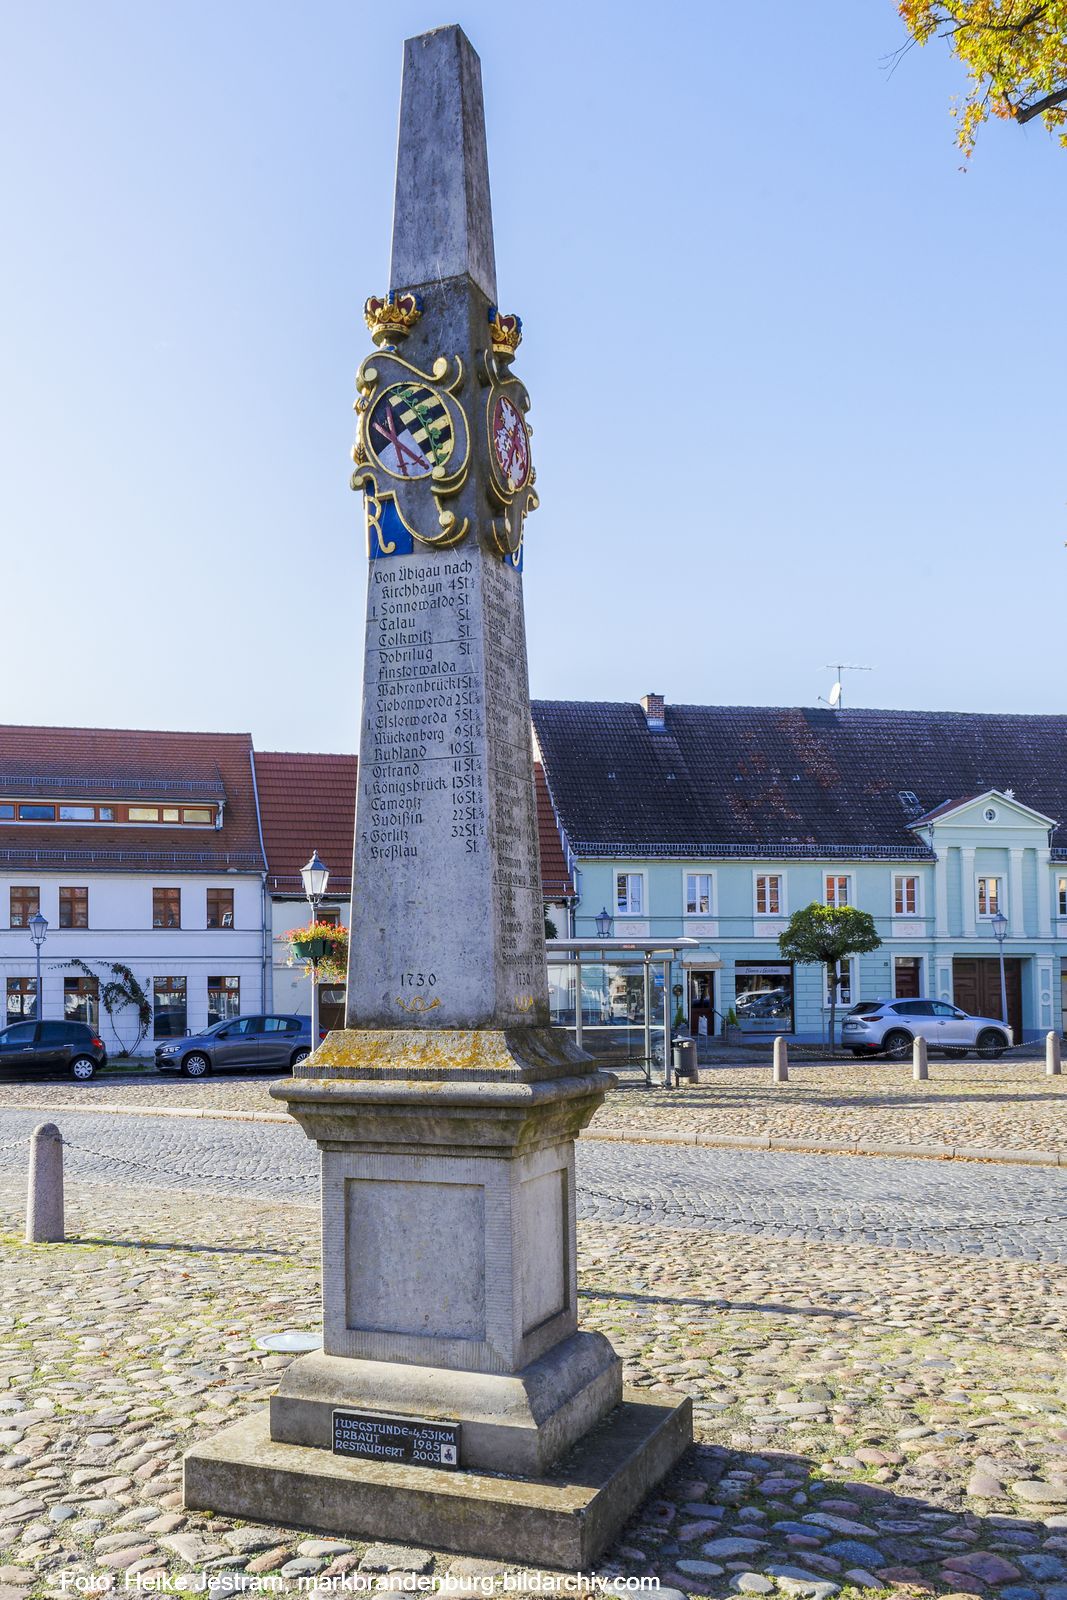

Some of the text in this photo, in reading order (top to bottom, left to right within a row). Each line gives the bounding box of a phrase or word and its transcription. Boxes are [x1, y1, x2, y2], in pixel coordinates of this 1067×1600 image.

[374, 560, 472, 584] Von Übigau nach
[382, 582, 442, 599] Kirchhayn
[381, 597, 454, 616] Sonnewalde
[379, 616, 415, 631] Calau
[379, 647, 433, 664] Dobrilug
[376, 695, 453, 713] Liebenwerda
[375, 712, 448, 729] Elsterwerda
[375, 745, 427, 762] Ruhland
[372, 763, 420, 778] Ortrand
[372, 778, 448, 796] Königsbrück
[401, 973, 437, 987] 1730
[335, 1430, 440, 1451] ERBAUT 1985
[335, 1440, 440, 1462] RESTAURIERT 2003
